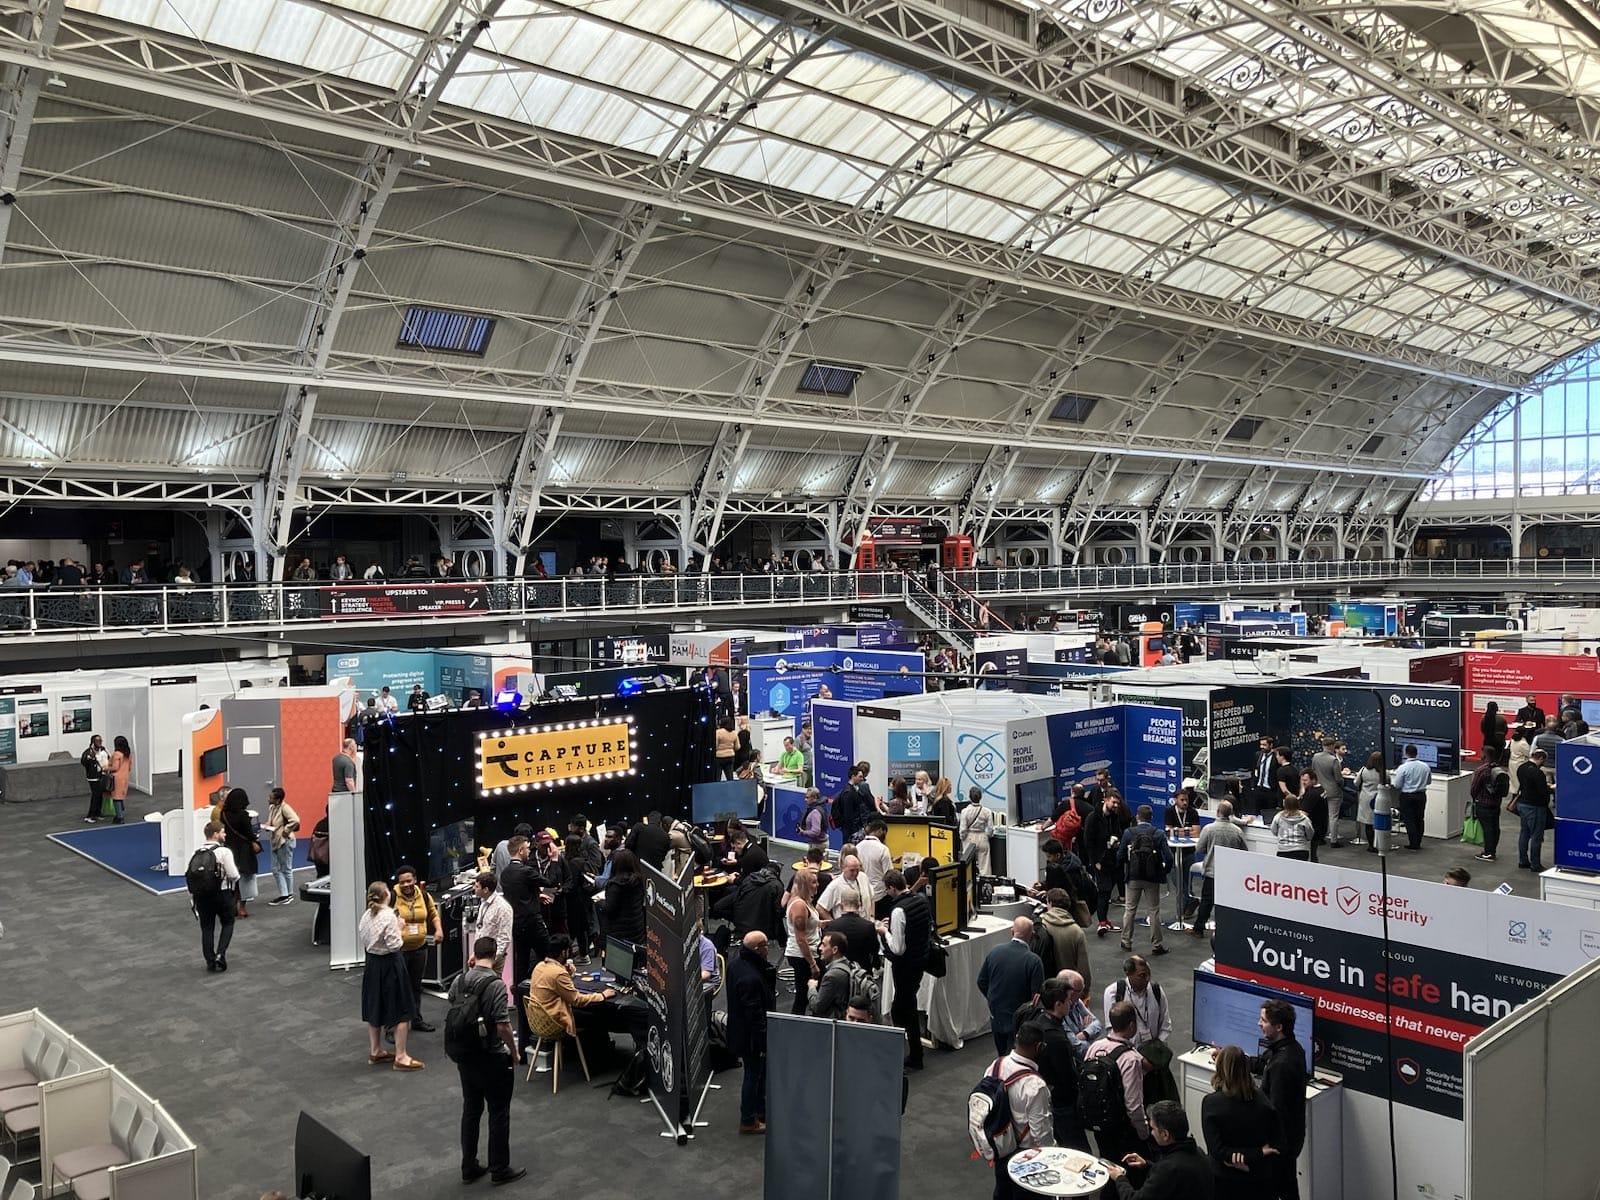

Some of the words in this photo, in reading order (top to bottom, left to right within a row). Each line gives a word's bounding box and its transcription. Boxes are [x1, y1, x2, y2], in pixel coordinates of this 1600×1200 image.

[1405, 697, 1451, 707] MALTEGO
[1213, 710, 1224, 719] THE
[1223, 707, 1241, 718] SPEED
[1241, 705, 1254, 714] AND
[1075, 721, 1084, 729] THE
[1089, 719, 1105, 728] HUMAN
[1105, 717, 1115, 725] RISK
[1150, 718, 1177, 729] PEOPLE
[1213, 716, 1244, 729] PRECISION
[1070, 727, 1098, 738] MANAGEMENT
[1099, 724, 1120, 735] PLATFORM
[1148, 726, 1177, 737] PREVENT
[1213, 730, 1221, 739] OF
[1221, 725, 1247, 738] COMPLEX
[1142, 734, 1177, 745] BREACHES
[1213, 732, 1260, 749] INVESTIGATIONS
[524, 740, 626, 763] CAPTURE
[1012, 746, 1033, 756] PEOPLE
[524, 764, 556, 777] THE
[565, 754, 627, 772] TALENT
[1012, 754, 1034, 765] PREVENT
[1012, 762, 1038, 774] BREACHES
[1567, 850, 1593, 859] DEMO
[1244, 874, 1329, 906] claranet
[1368, 893, 1409, 909] cyber
[1368, 904, 1428, 927] security
[1253, 923, 1315, 943] APPLICATIONS
[1381, 950, 1415, 963] CLOUD
[1246, 937, 1331, 979] You're
[1339, 958, 1365, 987] in
[1374, 971, 1441, 1004] safe
[1451, 982, 1533, 1020] han
[1494, 974, 1551, 991] NETWORK
[1317, 997, 1392, 1024] businesses
[1395, 1015, 1422, 1032] that
[1425, 1025, 1466, 1043] never
[1331, 1043, 1361, 1057] Application
[1362, 1051, 1384, 1063] security
[1347, 1055, 1365, 1065] speed
[1425, 1068, 1450, 1082] Security
[1425, 1077, 1442, 1086] cloud
[1442, 1080, 1454, 1089] and
